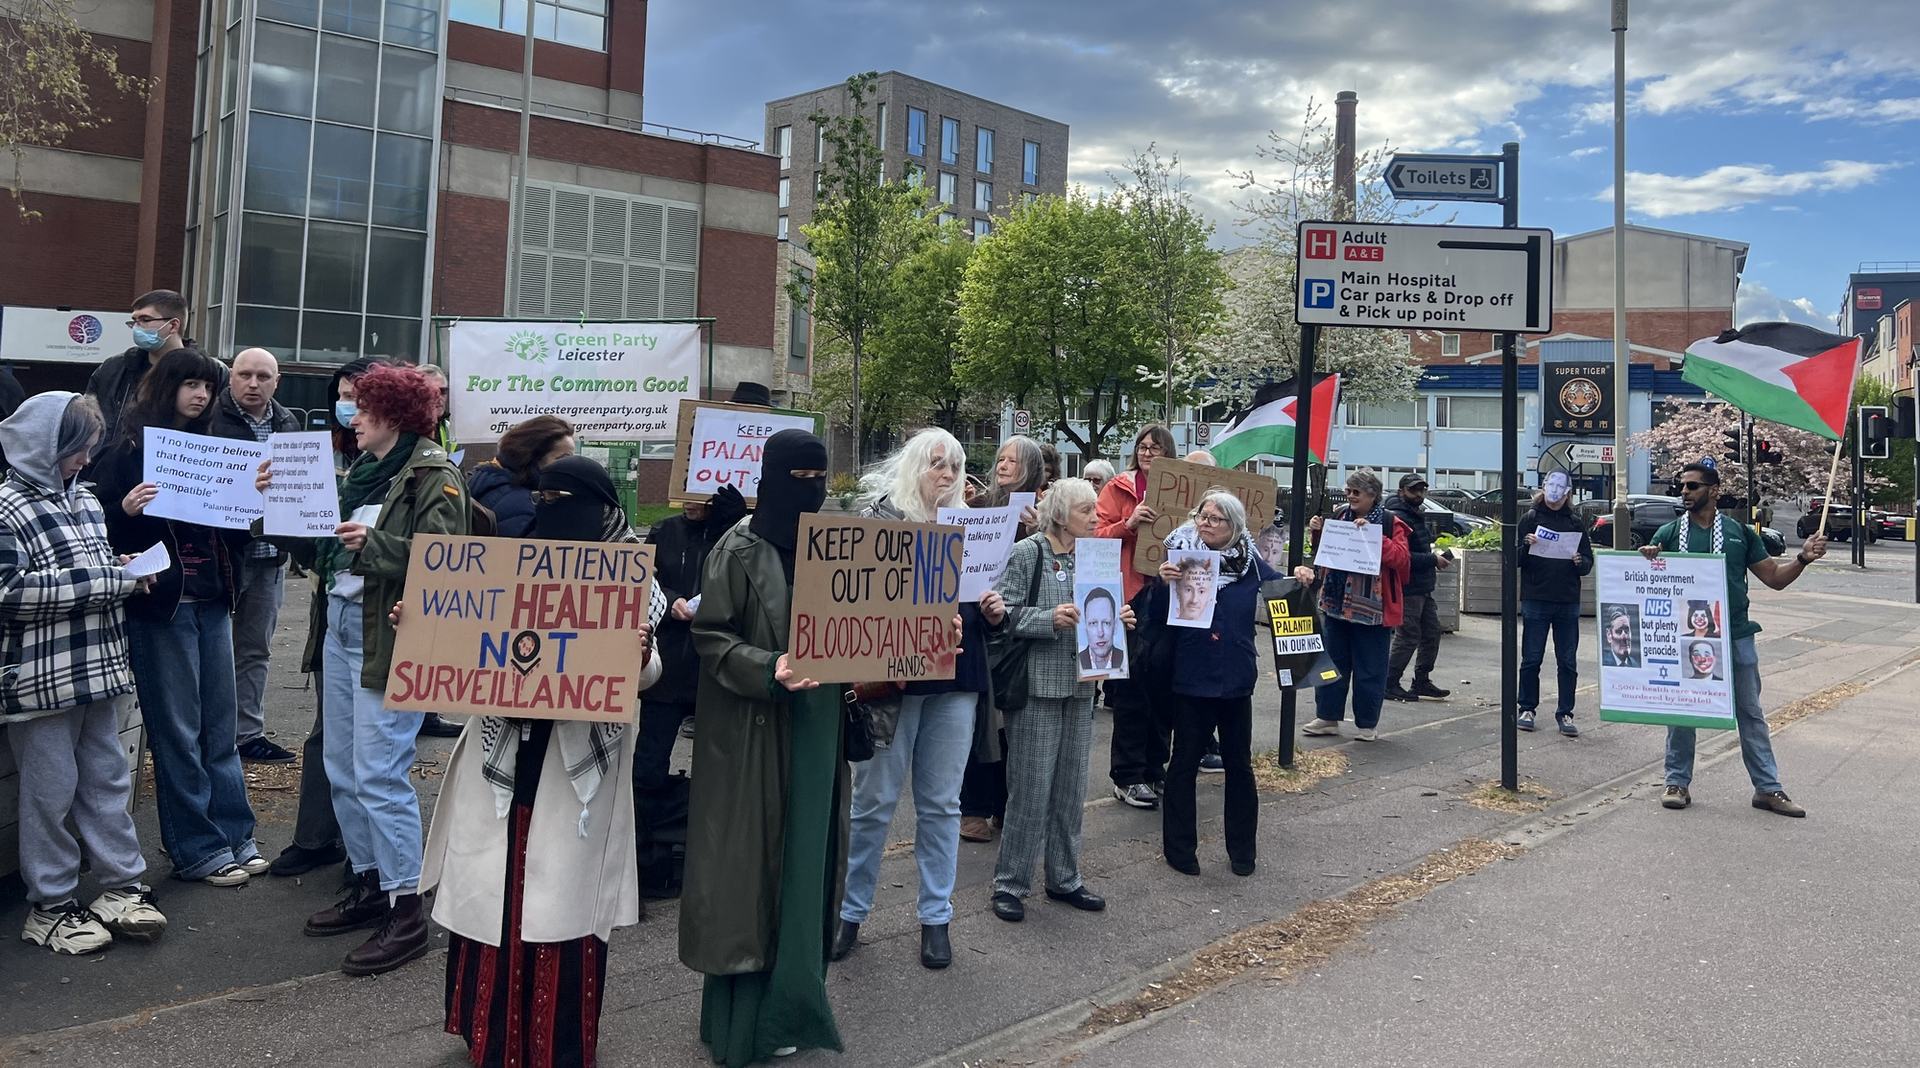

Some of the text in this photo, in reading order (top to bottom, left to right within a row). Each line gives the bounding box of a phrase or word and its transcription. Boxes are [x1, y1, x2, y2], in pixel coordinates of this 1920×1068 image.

[1406, 169, 1466, 185] Toilets
[1311, 232, 1331, 257] H
[1342, 231, 1387, 245] Adult
[1341, 272, 1457, 289] Main Hospital
[1311, 282, 1331, 306] P
[1340, 288, 1514, 307] Car parks & Drop off
[1339, 305, 1466, 322] & Pick up point
[554, 333, 658, 350] Green Party
[557, 348, 625, 362] Leicester
[1555, 367, 1606, 375] SUPER TIGER
[466, 375, 689, 393] For The Common Good
[490, 404, 668, 417] www.leicestergreenparty.org.uk
[1017, 415, 1027, 423] 20
[737, 423, 773, 436] KEEP
[168, 438, 182, 447] no
[184, 440, 219, 454] longer
[222, 446, 262, 458] believe
[303, 441, 320, 450] getting
[156, 450, 248, 472] that freedom and
[307, 455, 319, 465] light
[155, 464, 234, 485] democracy are
[696, 469, 751, 489] OUT
[312, 482, 324, 490] that
[1156, 471, 1265, 519] PALTIR
[203, 502, 264, 515] Palantir Founde
[319, 510, 334, 518] CEO
[224, 515, 245, 524] Peter
[957, 515, 984, 526] spend
[991, 515, 1001, 524] lot
[306, 523, 335, 532] Alex Karp
[967, 531, 1002, 542] talking to
[1538, 529, 1560, 542] NHS
[424, 541, 649, 584] OUR PATIENTS
[807, 526, 964, 605] KEEP OUR NHS
[966, 564, 981, 573] real
[1624, 570, 1695, 584] British government
[831, 567, 912, 604] OUT OF
[1635, 585, 1684, 598] no money for
[422, 583, 643, 630] WANT HEALTH
[1271, 602, 1287, 615] NO
[1646, 600, 1672, 615] NHS
[1276, 619, 1312, 634] PALANTIR
[1641, 618, 1678, 633] but plenty
[795, 613, 944, 660] BLOODSTAINED
[1644, 631, 1677, 643] to fund a
[479, 630, 578, 674] NOT
[1278, 637, 1321, 653] IN OUR NHS
[1643, 644, 1679, 657] genocide.
[888, 655, 926, 679] HANDS
[390, 660, 626, 713] SURVEILLANCE
[1691, 689, 1727, 697] workers
[1621, 693, 1662, 701] murdered
[1665, 694, 1676, 703] by
